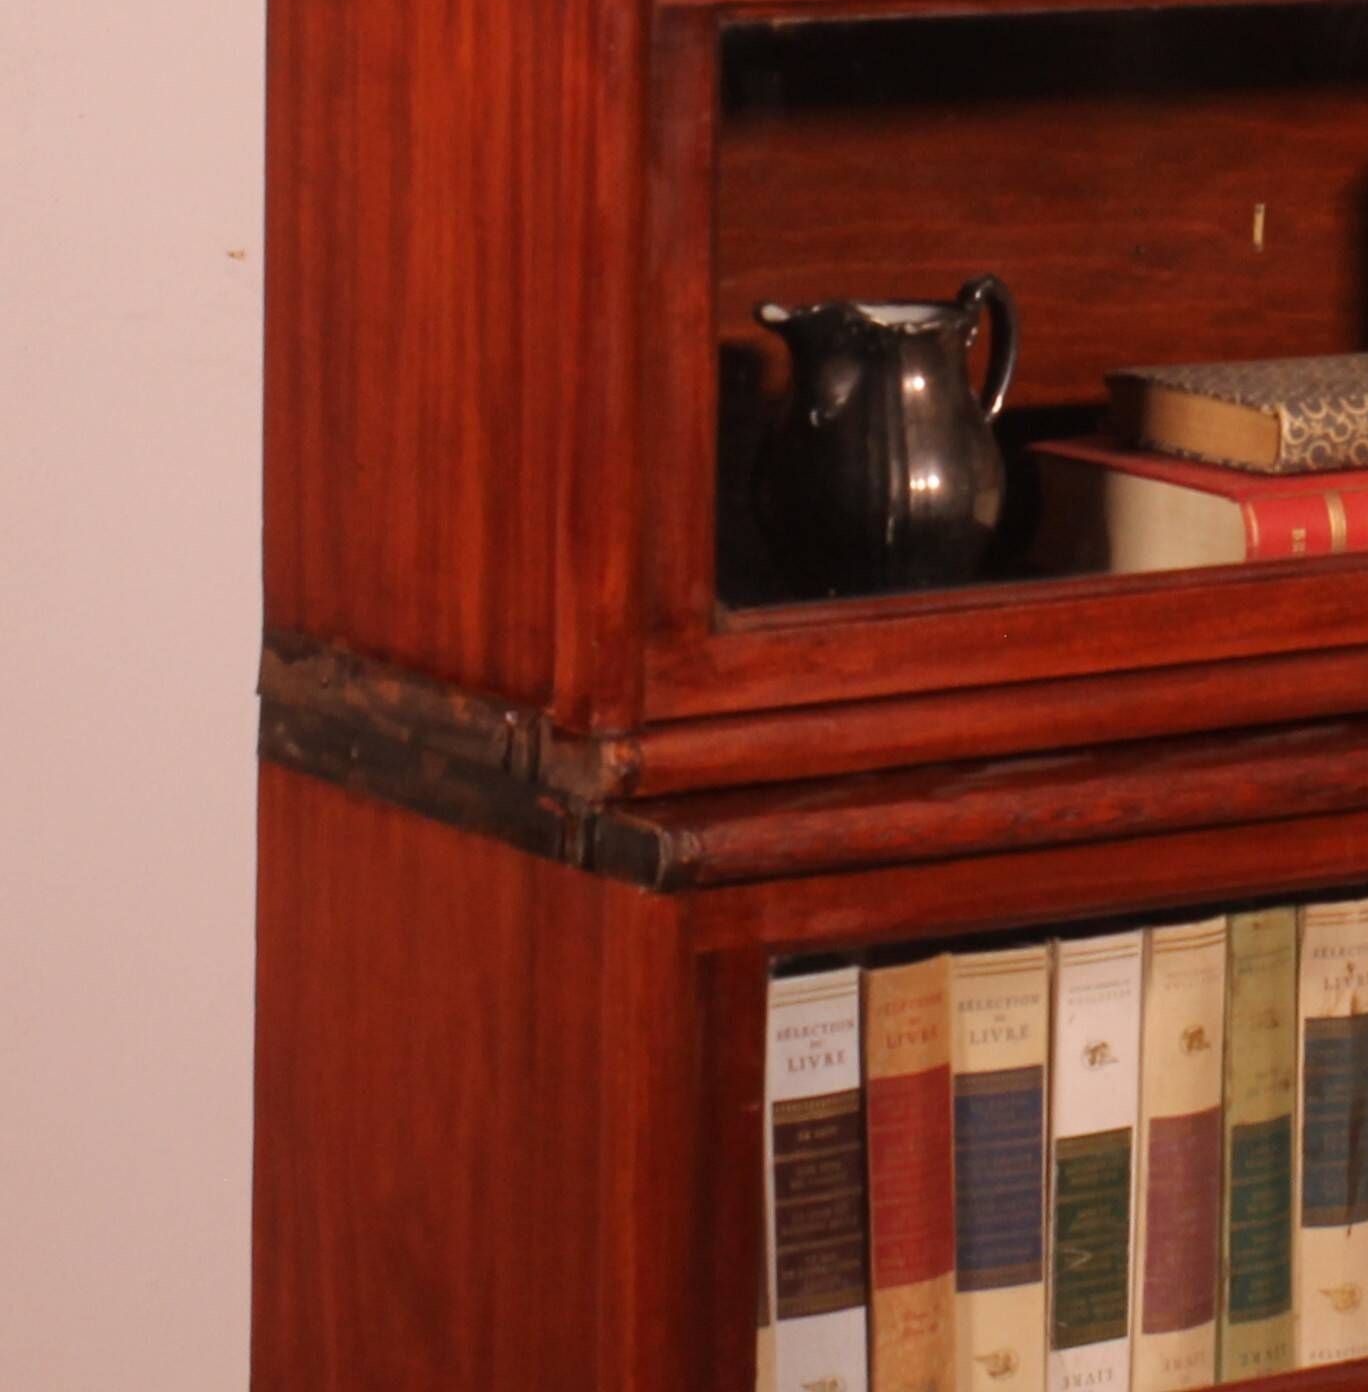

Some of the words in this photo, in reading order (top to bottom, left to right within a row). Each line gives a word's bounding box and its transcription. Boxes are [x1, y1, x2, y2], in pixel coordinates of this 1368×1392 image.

[887, 1024, 938, 1049] LIVRE
[970, 1025, 1030, 1046] LIVRE
[787, 1050, 847, 1073] LIVRE
